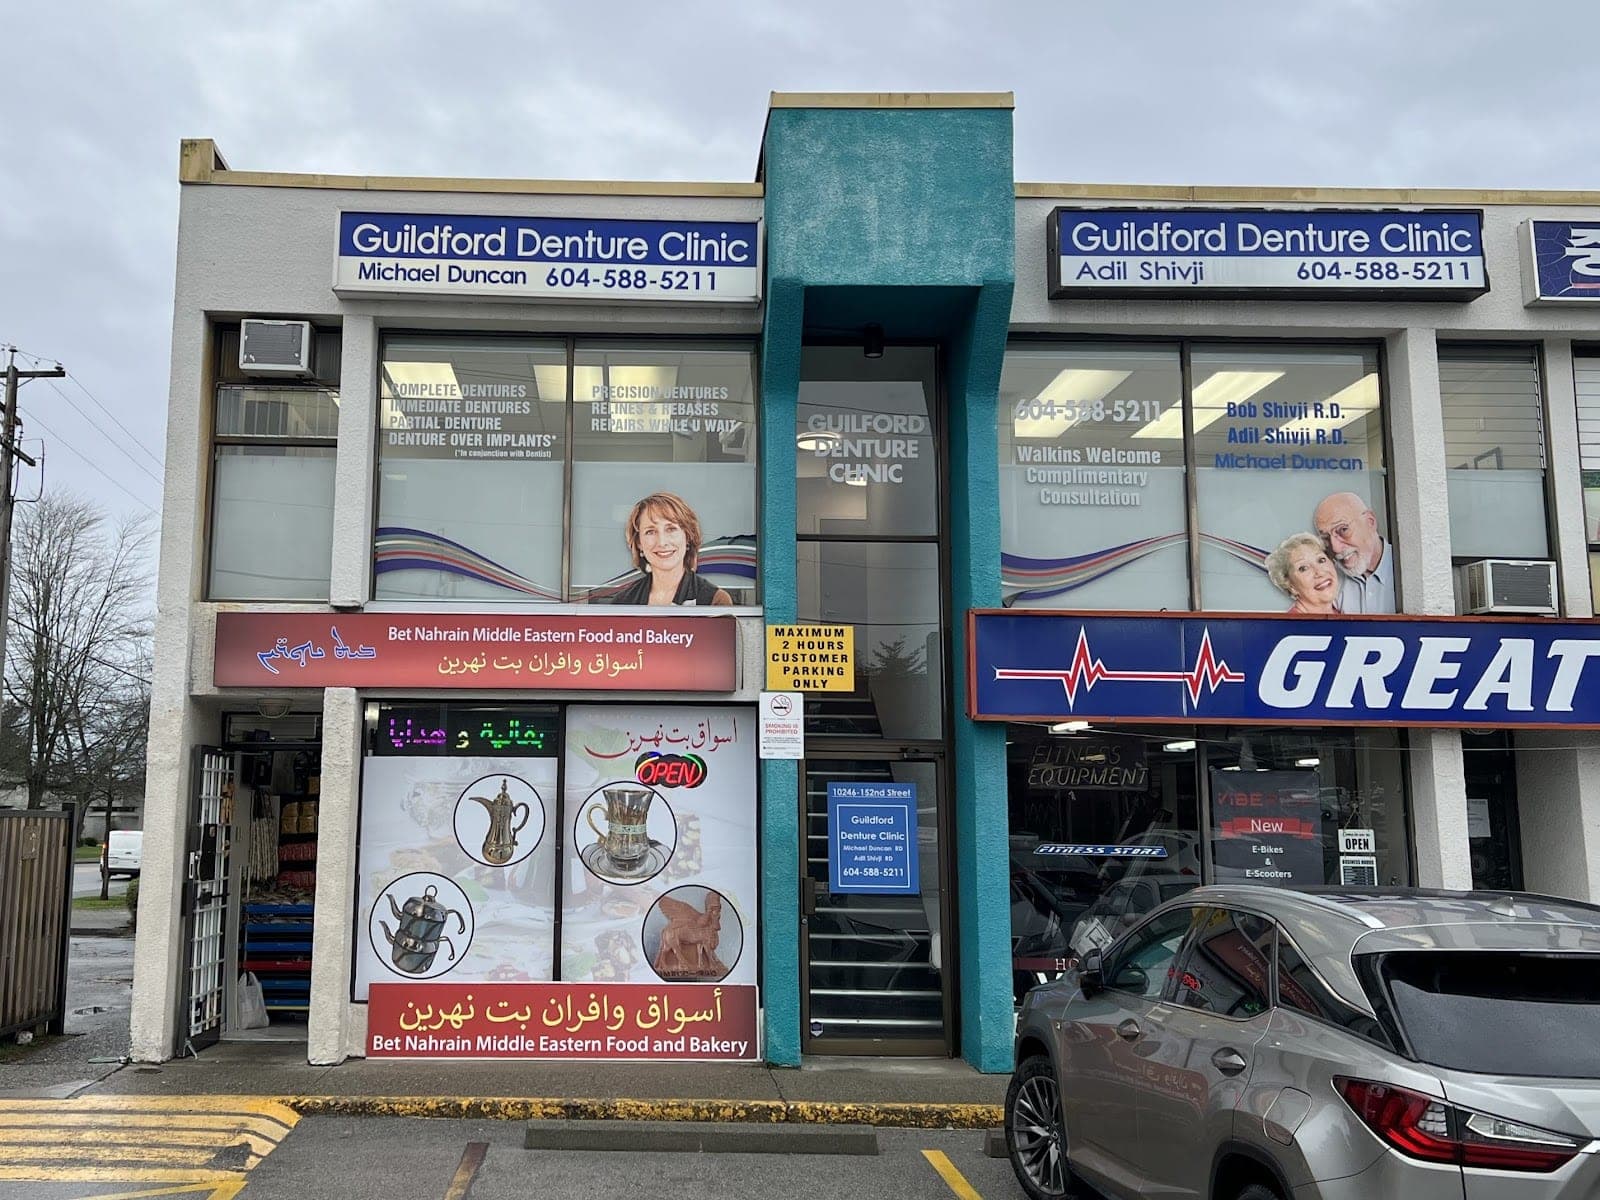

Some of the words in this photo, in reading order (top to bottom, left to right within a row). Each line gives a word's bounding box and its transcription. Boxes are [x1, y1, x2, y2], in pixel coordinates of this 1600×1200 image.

[352, 223, 506, 257] Guildford
[517, 229, 648, 260] Denture
[658, 231, 749, 263] Clinic
[1071, 221, 1227, 252] Guildford
[1238, 223, 1370, 252] Denture
[1380, 222, 1473, 253] Clinic
[358, 262, 439, 283] Michael
[448, 265, 527, 285] Duncan
[546, 267, 717, 291] 604-588-5211
[1078, 261, 1127, 281] Adil
[1139, 261, 1204, 284] Shivji
[1297, 261, 1471, 281] 604-588-5211
[390, 383, 457, 398] COMPLETE
[461, 385, 527, 398] DENTURES
[592, 385, 660, 400] PRECISION
[664, 386, 729, 400] DENTURES
[390, 399, 462, 414] IMMEDIATE
[465, 401, 531, 415] DENTURES
[591, 402, 644, 416] RELINES
[661, 402, 719, 417] REBASES
[1015, 399, 1161, 422] 604-588-5211
[1228, 401, 1258, 418] Bob
[1264, 402, 1309, 421] Shivji
[1314, 403, 1345, 419] R.D.
[390, 416, 441, 430] PARTIAL
[444, 416, 502, 431] DENTURE
[591, 418, 645, 433] REPAIRS
[648, 418, 689, 433] WHILE
[692, 418, 700, 432] U
[704, 418, 737, 434] WAIT
[808, 414, 925, 434] GUILFORD
[389, 432, 447, 446] DENTURE
[450, 433, 484, 447] OVER
[1228, 428, 1260, 445] Adil
[1265, 428, 1311, 447] Shivji
[1316, 430, 1347, 445] R.D.
[468, 449, 509, 459] conjunction
[509, 449, 525, 458] with
[815, 439, 919, 459] DENTURE
[1018, 446, 1081, 464] Walkins
[1086, 446, 1161, 465] Welcome
[1216, 454, 1287, 469] Michael
[1292, 455, 1362, 470] Duncan
[1026, 467, 1148, 488] Complimentary
[1040, 488, 1141, 506] Consultation
[388, 627, 413, 642] Bet
[414, 627, 470, 643] Nahrain
[472, 627, 522, 644] Middle
[525, 629, 575, 644] Eastern
[578, 629, 613, 644] Food
[616, 629, 643, 644] and
[646, 629, 694, 647] Bakery
[775, 628, 844, 637] MAXIMUM
[782, 641, 789, 649] 2
[797, 641, 844, 650] HOURS
[438, 652, 485, 674] نهرين
[493, 654, 523, 673] بت
[529, 651, 582, 675] وافران
[588, 649, 643, 675] أسواق
[772, 654, 848, 663] CUSTOMER
[783, 666, 844, 676] PARKING
[1258, 635, 1600, 711] GREAT
[793, 679, 828, 688] ONLY
[665, 728, 690, 750] بت
[1032, 745, 1121, 765] FITNESS
[639, 762, 697, 785] OPEN
[1028, 767, 1149, 786] EQUIPMENT
[887, 789, 911, 797] Street
[851, 816, 894, 825] Guildford
[1251, 819, 1284, 833] New
[841, 832, 877, 841] Denture
[879, 832, 905, 841] Clinic
[1345, 838, 1369, 850] OPEN
[1038, 845, 1106, 854] FITNESS
[1109, 846, 1162, 856] STORE
[1252, 845, 1284, 854] E-Bikes
[1264, 857, 1272, 866] &
[843, 868, 904, 877] 604-588-5211
[1245, 869, 1293, 879] E-Scooters
[399, 994, 476, 1033] نهرين
[486, 998, 532, 1031] بت
[542, 993, 625, 1033] وافران
[635, 987, 723, 1034] أسواق
[372, 1035, 401, 1052] Bet
[405, 1036, 472, 1052] Nahrain
[476, 1035, 536, 1053] Middle
[539, 1036, 602, 1053] Eastern
[606, 1037, 649, 1055] Food
[653, 1037, 685, 1055] and
[689, 1038, 749, 1057] Bakery
